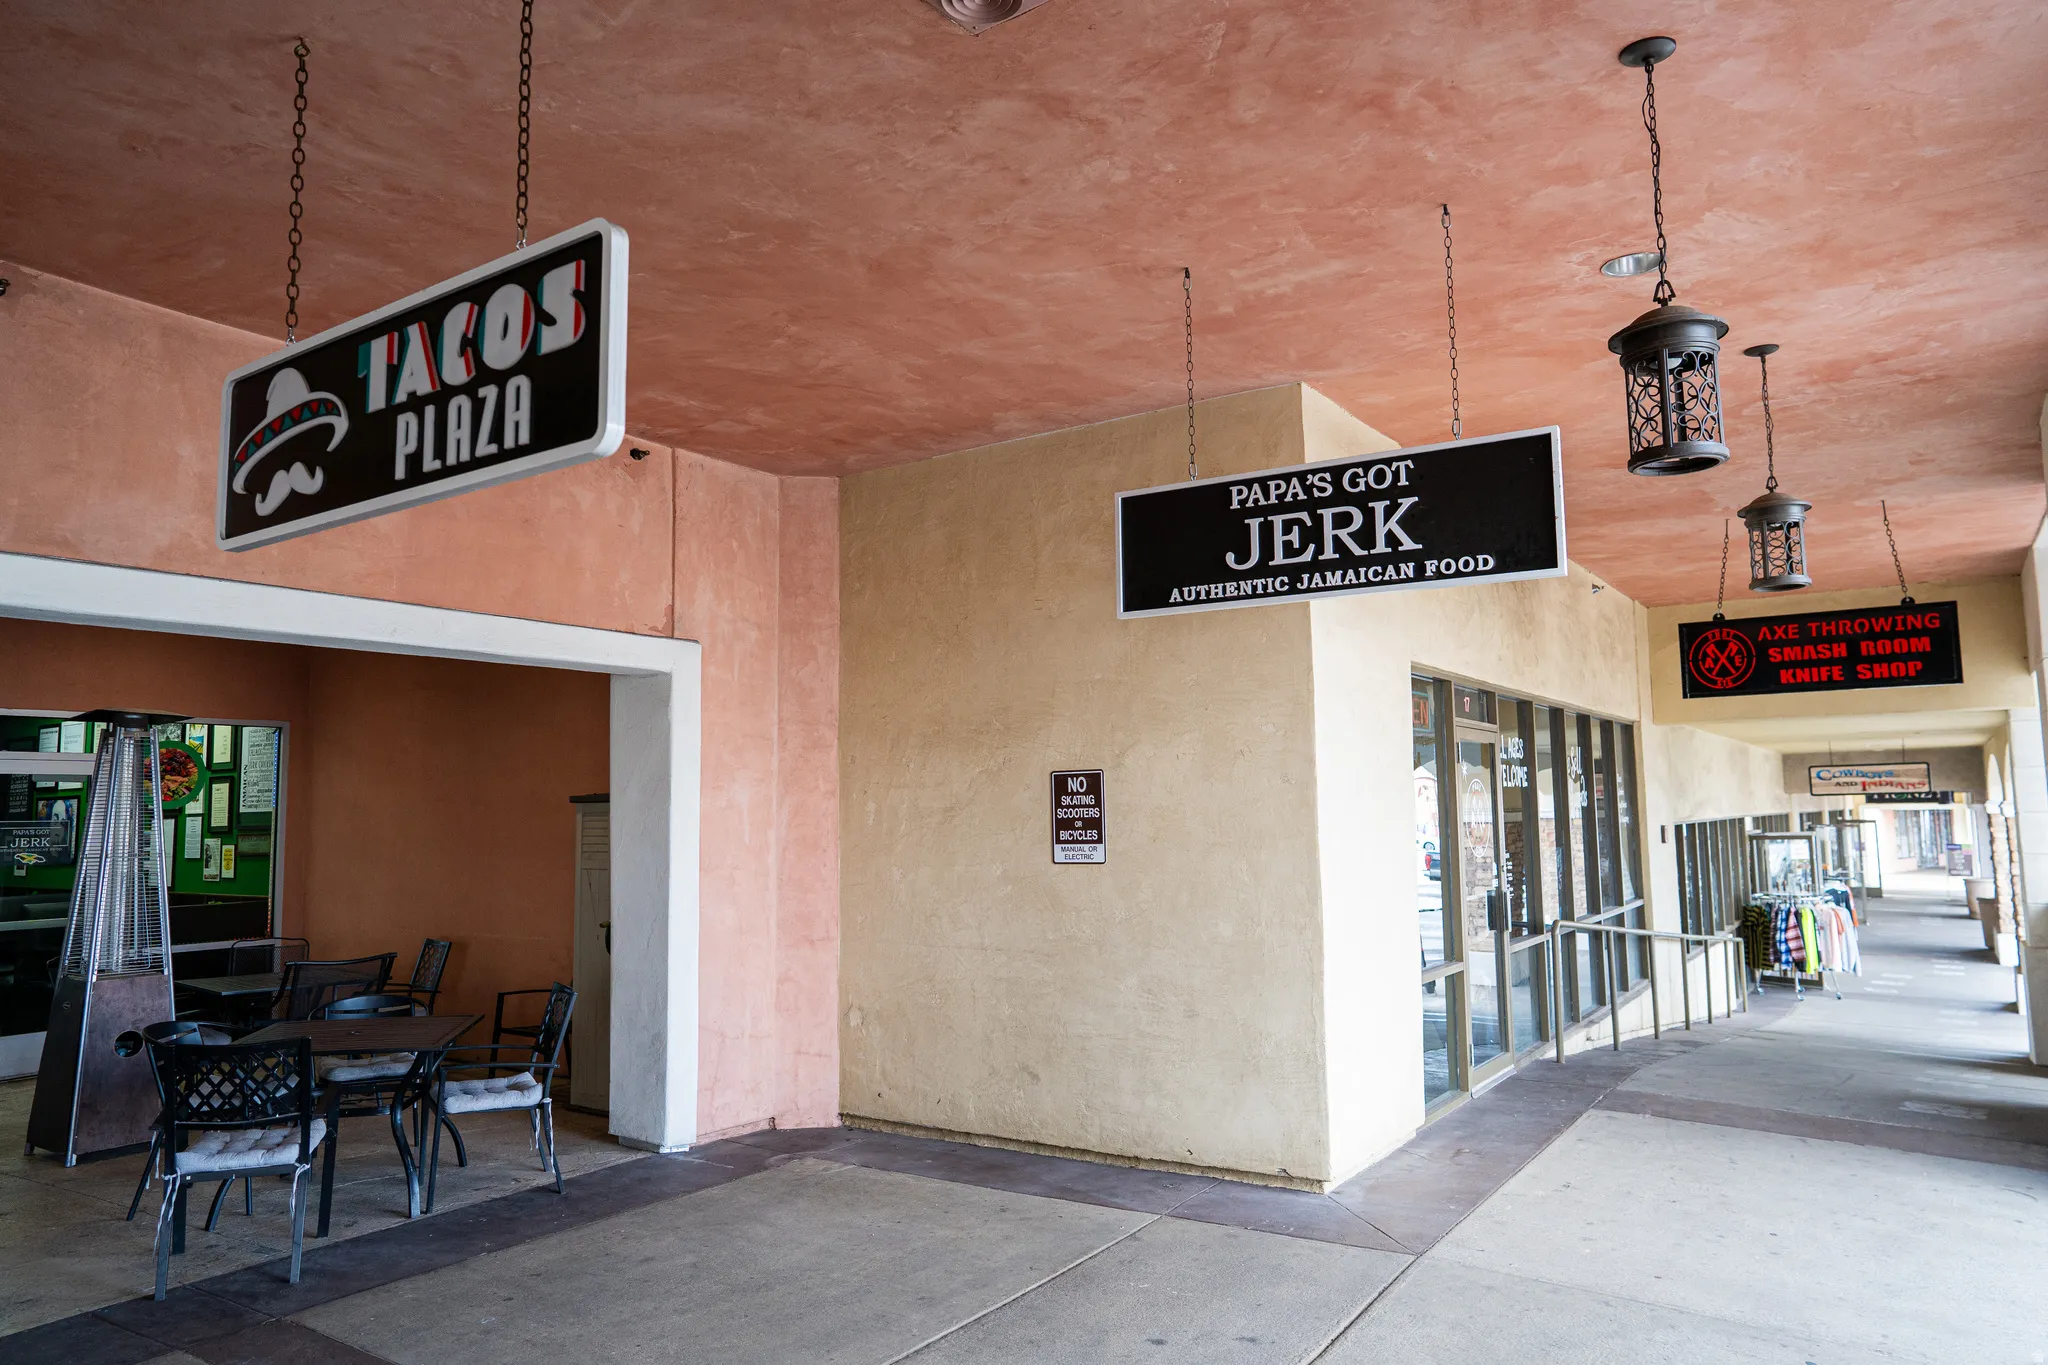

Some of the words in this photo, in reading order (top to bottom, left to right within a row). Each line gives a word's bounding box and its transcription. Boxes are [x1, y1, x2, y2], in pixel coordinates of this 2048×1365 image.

[357, 258, 586, 414] TACOS
[394, 374, 532, 481] PLAZA
[1229, 472, 1333, 509] PAPA'S
[1342, 459, 1414, 494] GOT
[1225, 496, 1422, 570] JERK
[1169, 576, 1289, 603] AUTHENTIC
[1296, 563, 1414, 590] JAMAICAN
[1424, 554, 1494, 577] FOOD
[1757, 624, 1799, 641] AXE
[1807, 612, 1940, 637] THROWING
[1767, 642, 1847, 663] SMASH
[1860, 636, 1931, 656] ROOM
[1779, 665, 1845, 684] KNIFE
[1855, 661, 1923, 680] SHOP
[1067, 776, 1087, 793] NO
[1501, 764, 1529, 788] ELCOME
[1815, 769, 1895, 781] COWBOYS
[1860, 780, 1928, 792] INDIANS
[1061, 795, 1095, 806] SKATING
[1057, 807, 1100, 819] SCOOTERS
[10, 837, 51, 848] JERK
[1059, 830, 1098, 841] BICYCLES
